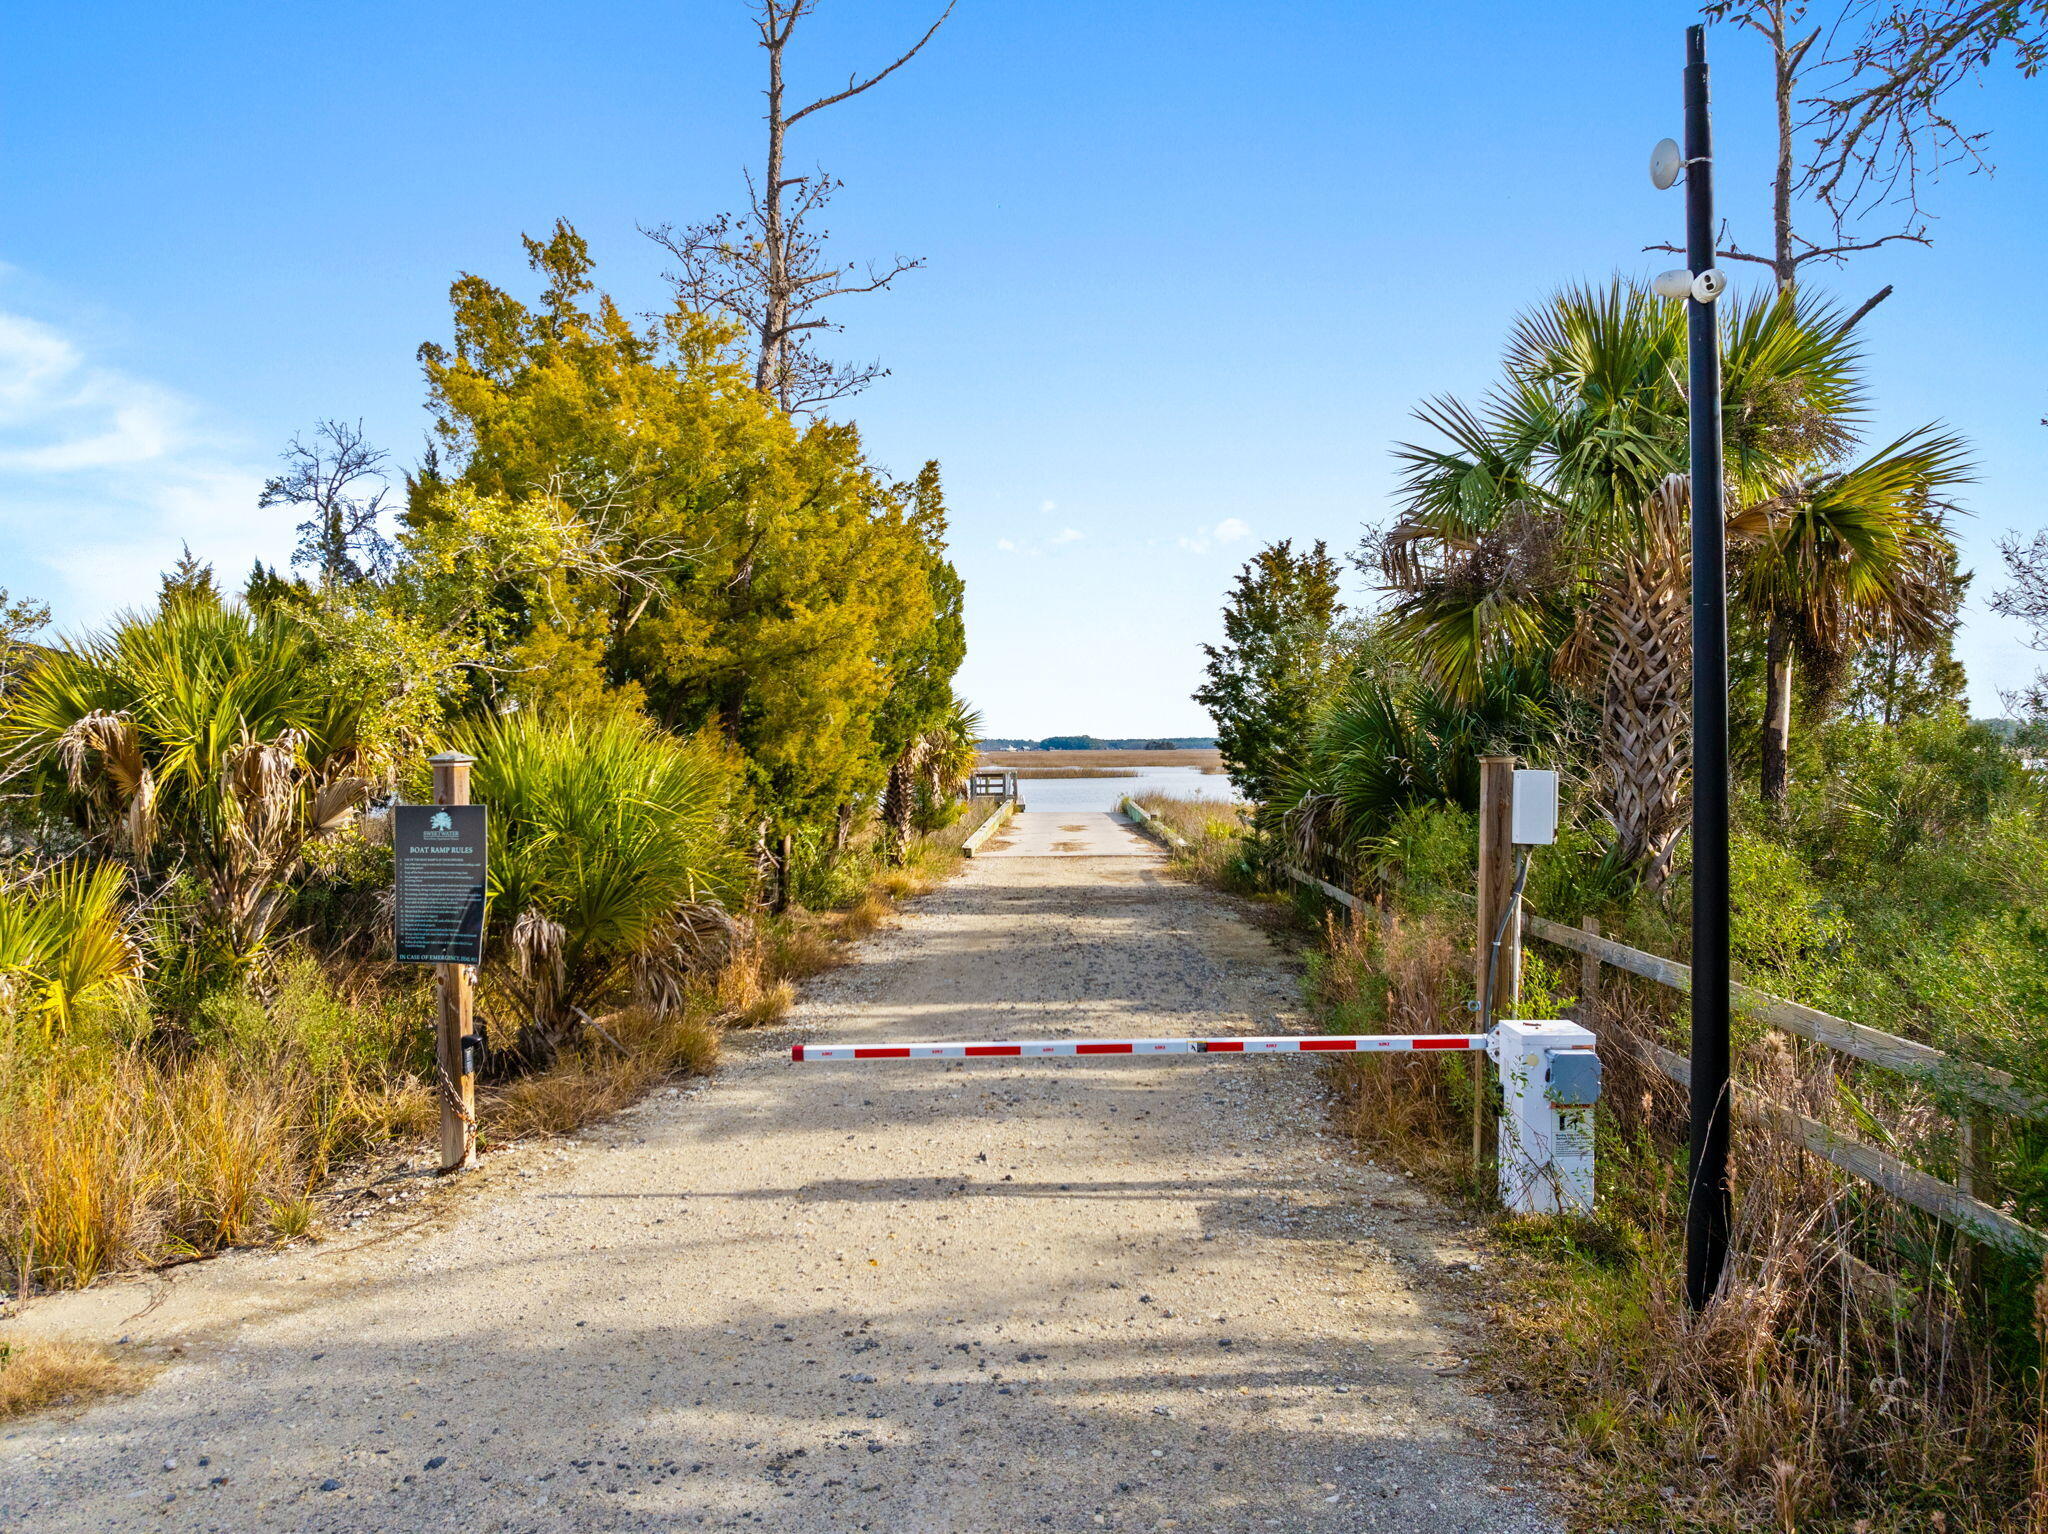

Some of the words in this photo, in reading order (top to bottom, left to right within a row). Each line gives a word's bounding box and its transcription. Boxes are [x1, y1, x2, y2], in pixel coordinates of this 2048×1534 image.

[410, 846, 430, 854] BOAT
[430, 846, 450, 854] RAMP
[452, 846, 473, 854] RULES
